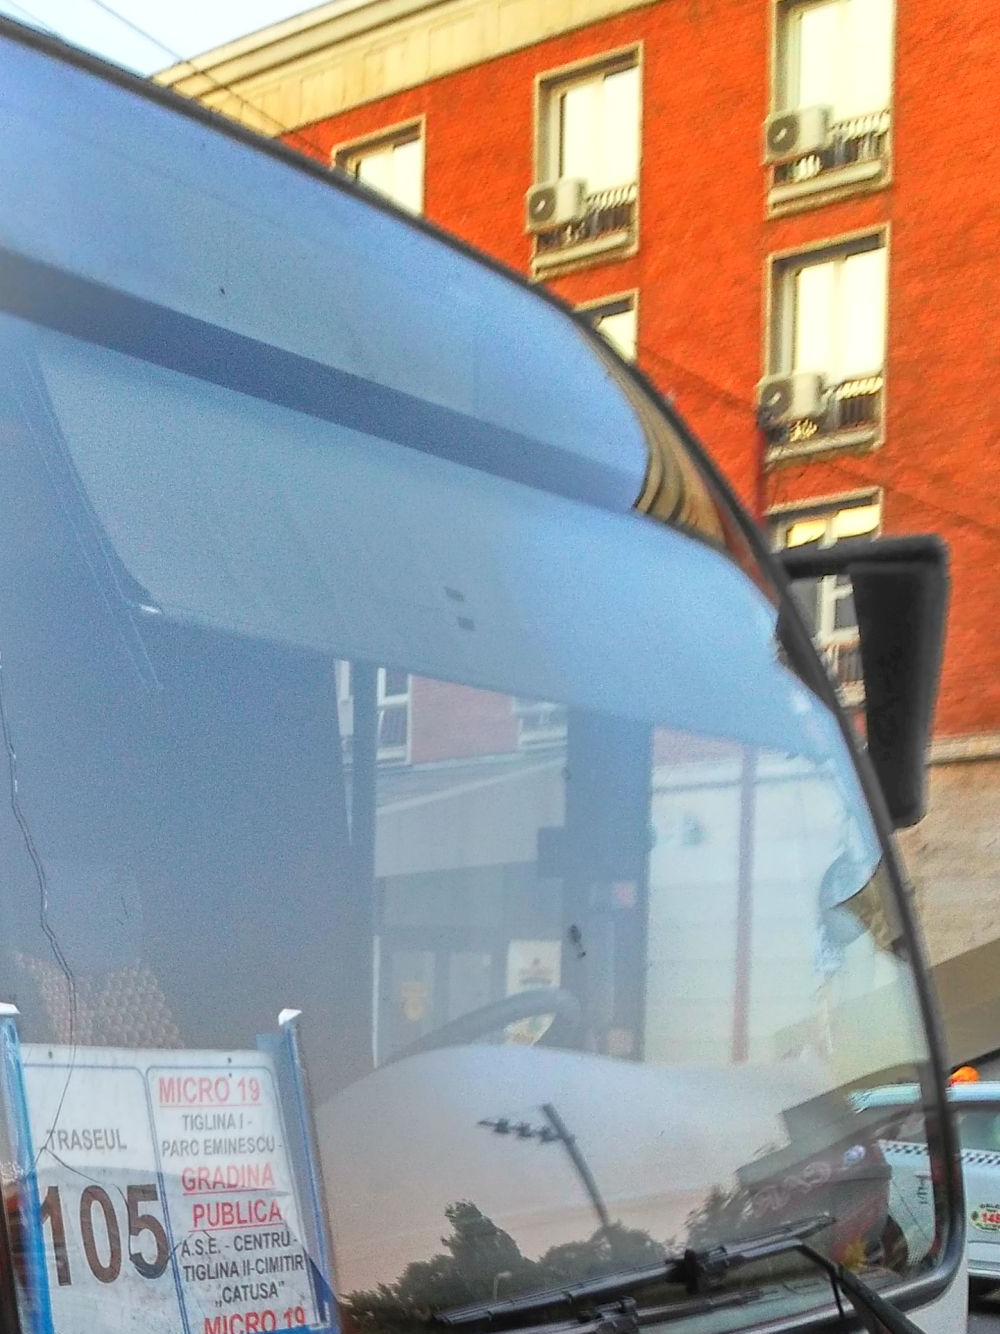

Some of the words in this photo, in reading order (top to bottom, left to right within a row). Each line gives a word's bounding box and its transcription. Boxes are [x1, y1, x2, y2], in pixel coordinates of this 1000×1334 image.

[159, 1076, 231, 1104] MICRO
[238, 1076, 261, 1102] 19
[182, 1113, 237, 1131] TIGLINA
[46, 1128, 128, 1151] TRASEUL
[162, 1139, 199, 1157] PARC
[204, 1135, 275, 1156] EMINESCU
[182, 1162, 275, 1192] GRADINA
[192, 1199, 282, 1228] PUBLICA
[40, 1183, 169, 1287] 105
[181, 1237, 221, 1257] A.S.E.
[233, 1230, 290, 1252] CENTRU
[183, 1260, 239, 1282] TIGLINA
[283, 1305, 306, 1329] 19
